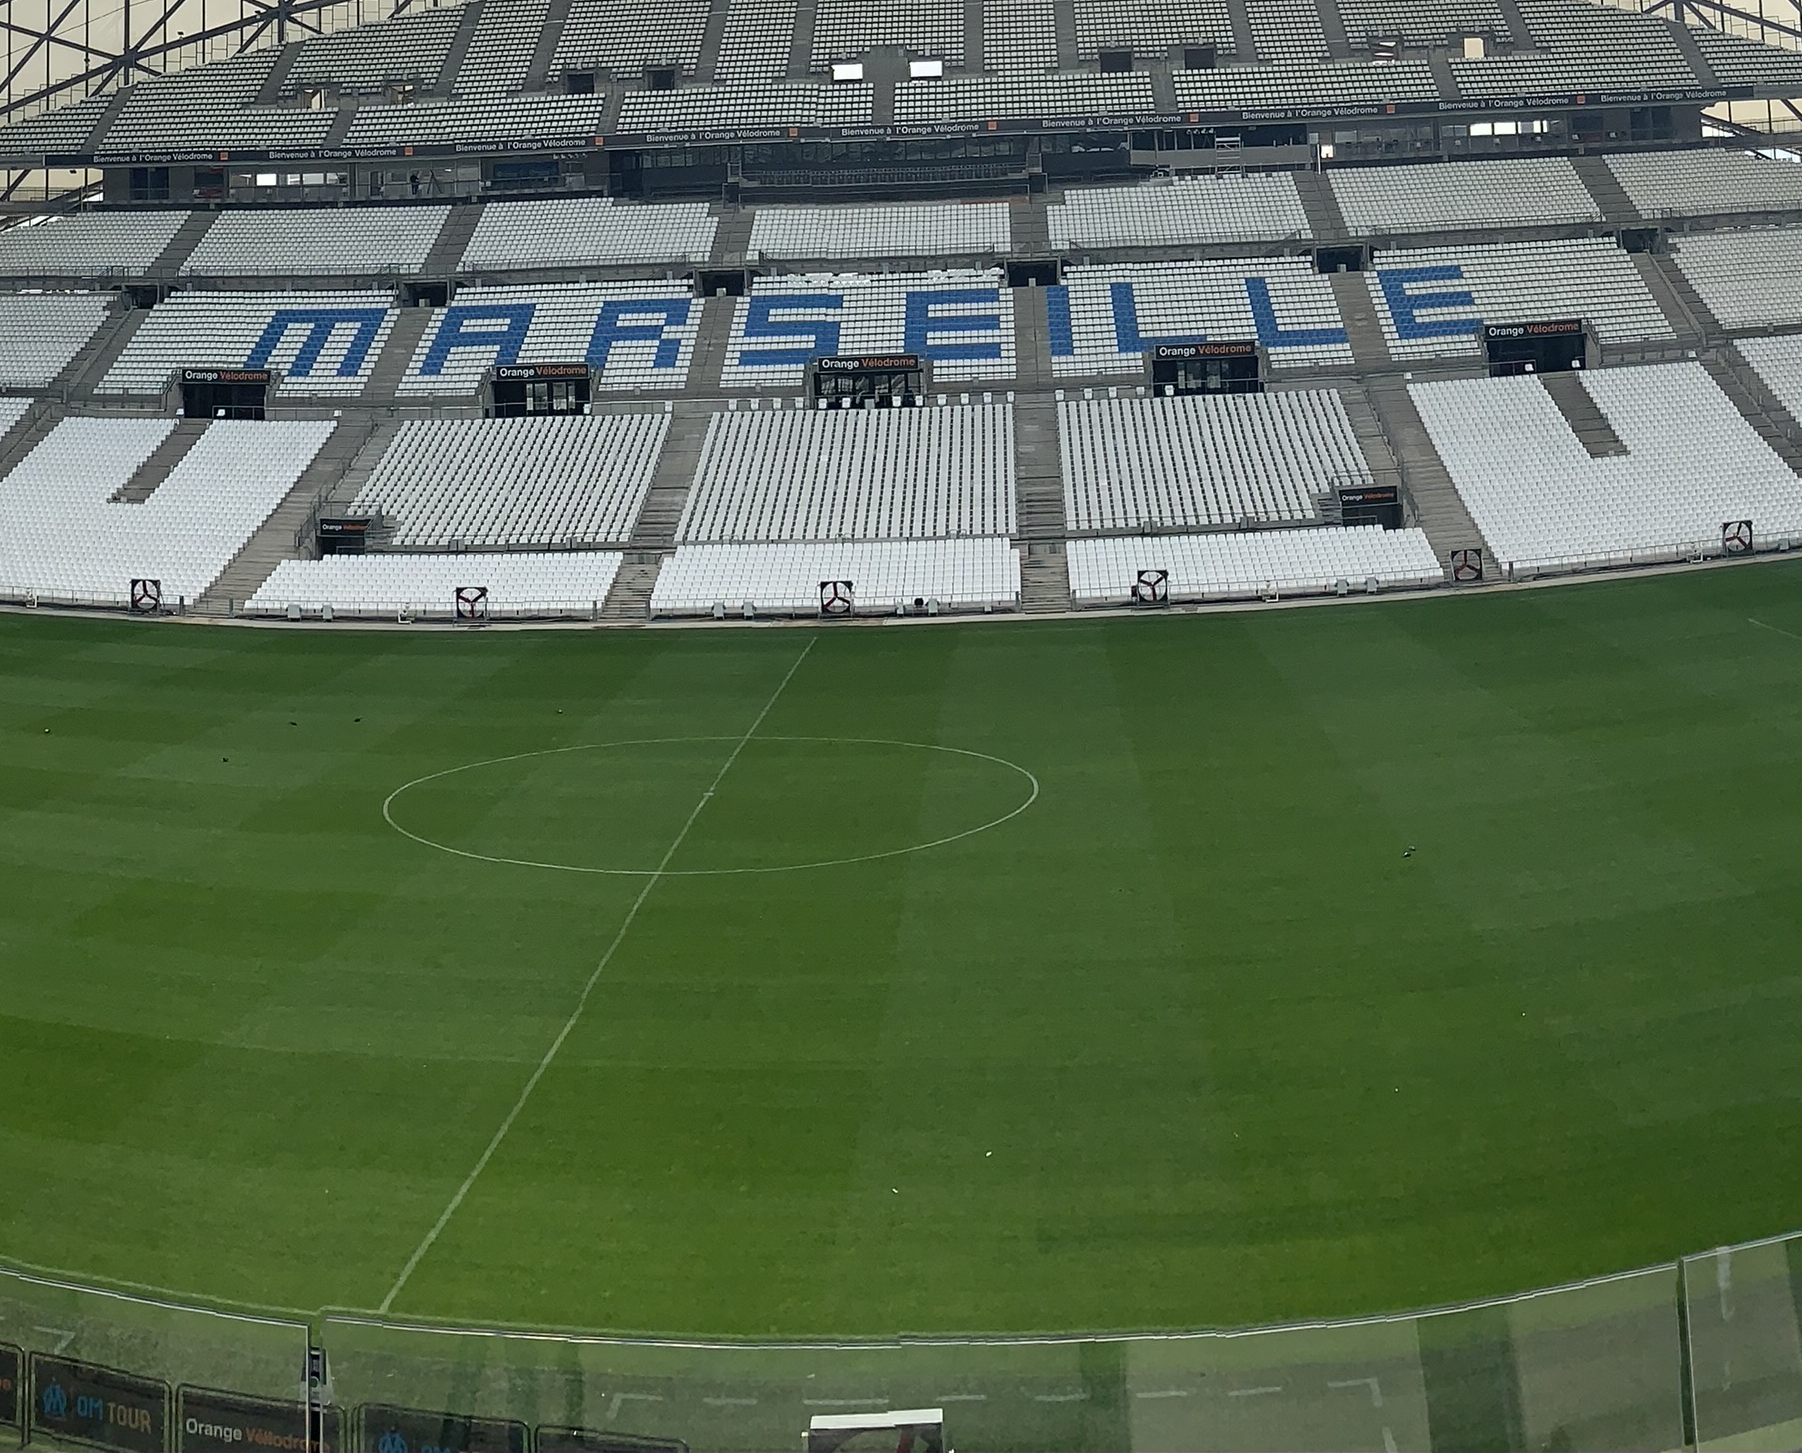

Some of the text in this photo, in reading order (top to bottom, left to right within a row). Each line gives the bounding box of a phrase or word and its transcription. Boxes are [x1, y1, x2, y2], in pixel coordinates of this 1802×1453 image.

[1601, 95, 1641, 103] Bienvenue
[1651, 91, 1683, 101] l'Orange
[1685, 89, 1727, 99] Vélodrome
[1489, 99, 1525, 109] l'Orange
[1527, 97, 1569, 106] Vélodrome
[1242, 111, 1285, 119] Bienvenue
[1296, 109, 1332, 119] l'Orange
[1333, 107, 1378, 116] Vélodrome
[1043, 119, 1087, 128] Bienvenue
[1097, 117, 1134, 127] l'Orange
[1136, 115, 1181, 124] Vélodrome
[647, 135, 687, 143] Bienvenue
[699, 131, 734, 141] l'Orange
[736, 129, 780, 139] Vélodrome
[841, 127, 885, 136] Bienvenue
[896, 125, 931, 135] l'Orange
[933, 123, 979, 133] Vélodrome
[455, 144, 497, 153] Bienvenue
[507, 141, 542, 151] l'Orange
[543, 138, 585, 148] Vélodrome
[93, 154, 127, 163] Bienvenue
[139, 153, 171, 163] l'Orange
[173, 153, 213, 161] Vélodrome
[269, 151, 307, 159] Bienvenue
[319, 149, 351, 159] l'Orange
[355, 147, 397, 157] Vélodrome
[243, 264, 1484, 378] MARSEILLE
[1489, 323, 1579, 337] Orange Vélodrome
[1159, 345, 1251, 357] Orange Vélodrome
[821, 357, 915, 370] Orange Vélodrome
[185, 371, 268, 381] Orange Vélodrome
[499, 366, 587, 378] Orange Vélodrome
[77, 1396, 151, 1434] OM TOUR
[186, 1418, 242, 1442] Orange
